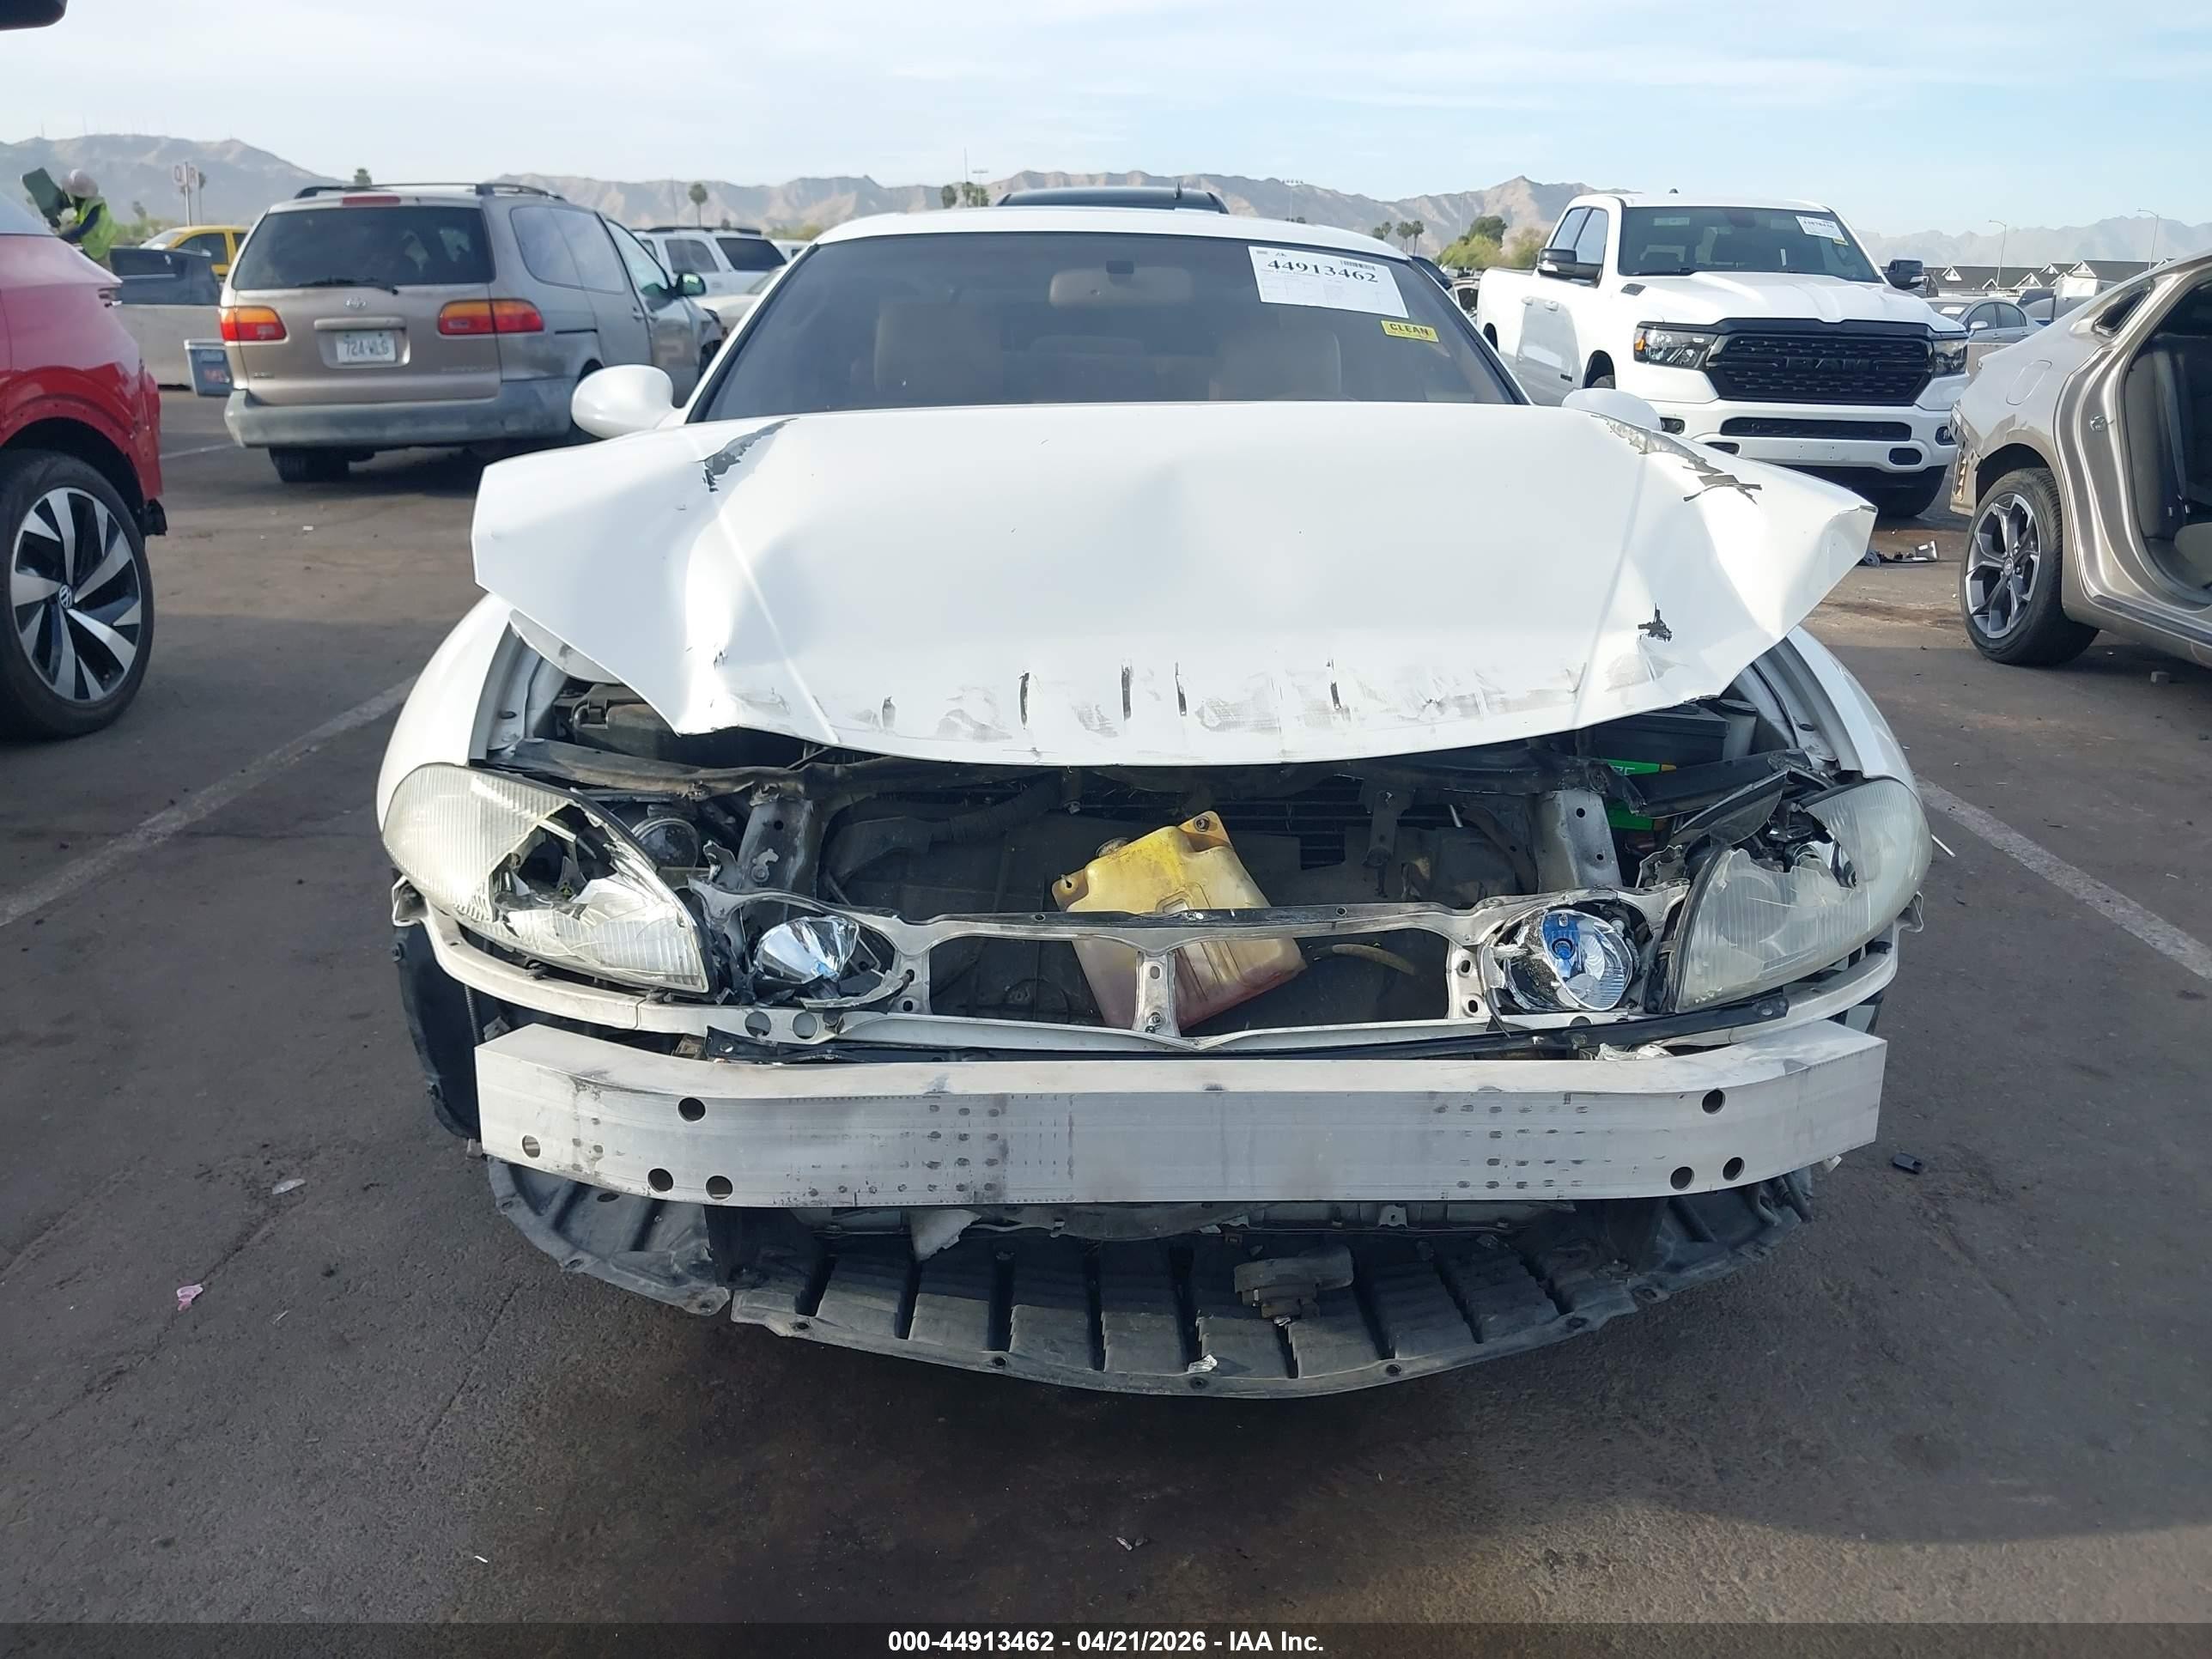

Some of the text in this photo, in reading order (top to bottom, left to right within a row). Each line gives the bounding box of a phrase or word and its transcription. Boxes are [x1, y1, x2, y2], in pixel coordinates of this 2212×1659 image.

[1267, 259, 1378, 283] 44913462
[1389, 323, 1429, 336] CLEAN
[1786, 356, 1869, 371] RAM
